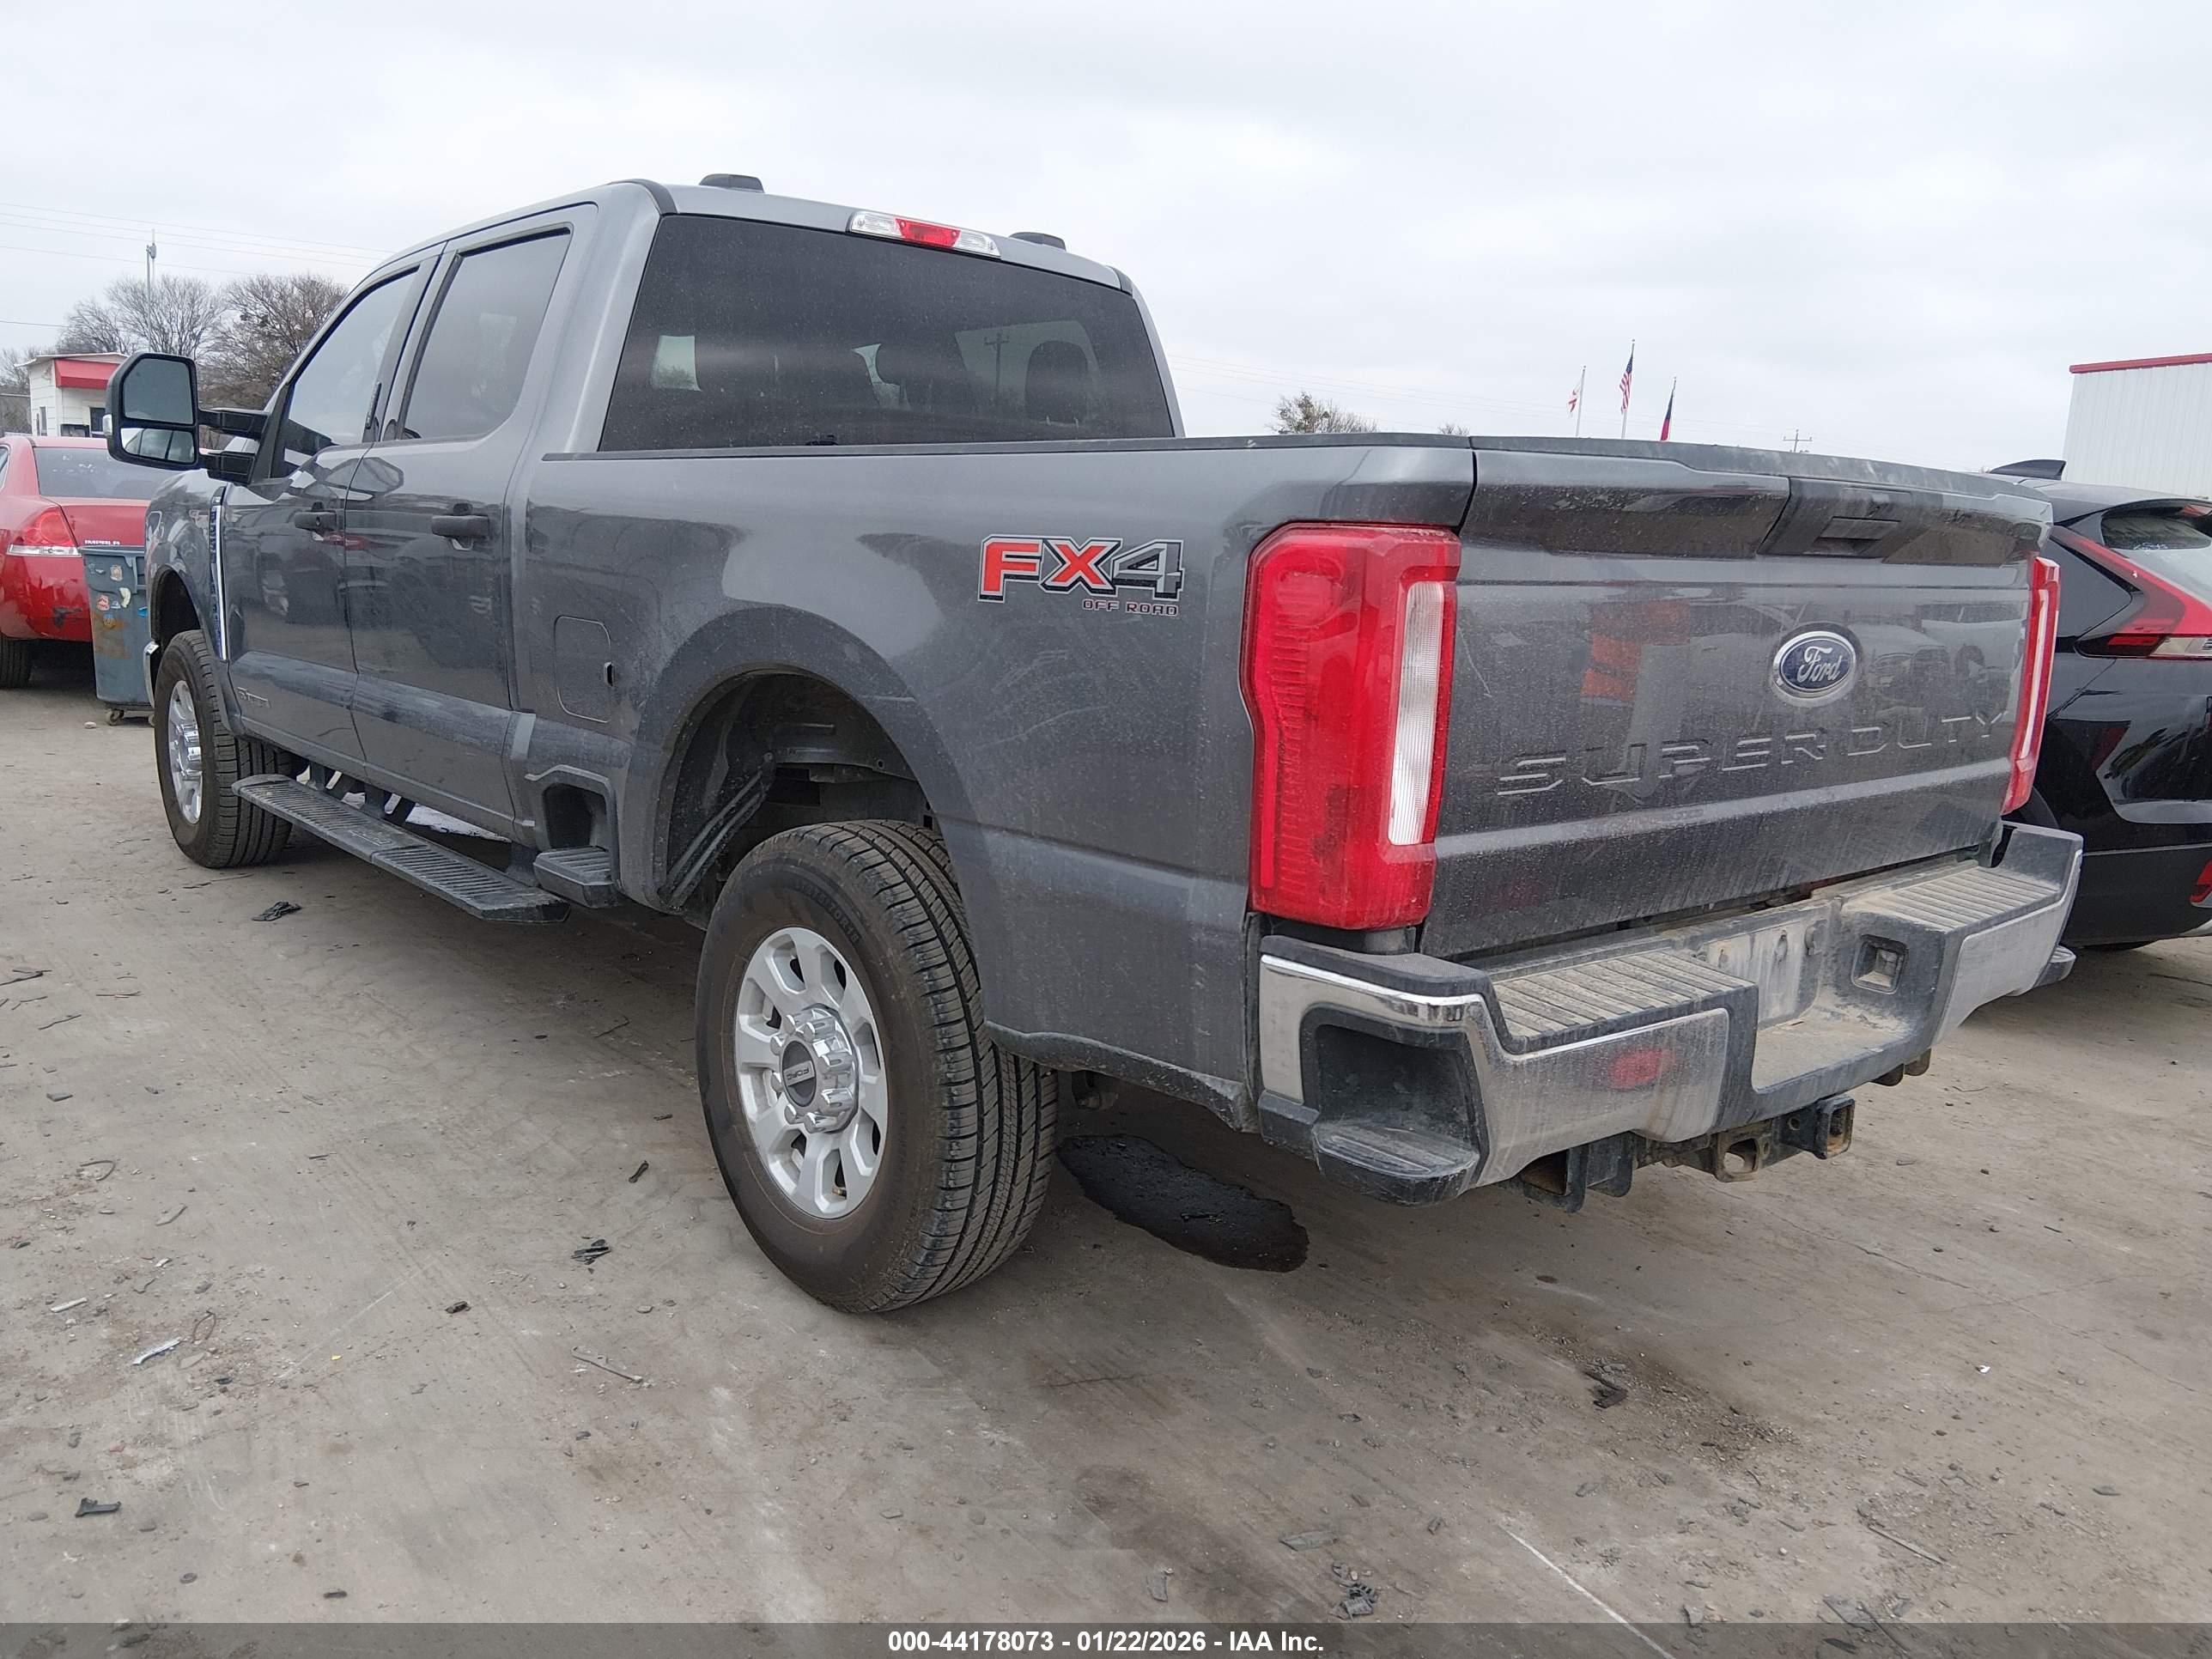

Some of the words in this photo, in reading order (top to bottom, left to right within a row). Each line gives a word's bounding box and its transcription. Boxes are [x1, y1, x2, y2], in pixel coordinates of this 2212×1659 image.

[978, 534, 1185, 603] FX4
[1081, 599, 1120, 612] OFF
[1125, 601, 1179, 617] ROAD
[1796, 645, 1843, 684] Ford
[1498, 728, 1828, 796] SUPER
[1847, 709, 2008, 757] DUTY
